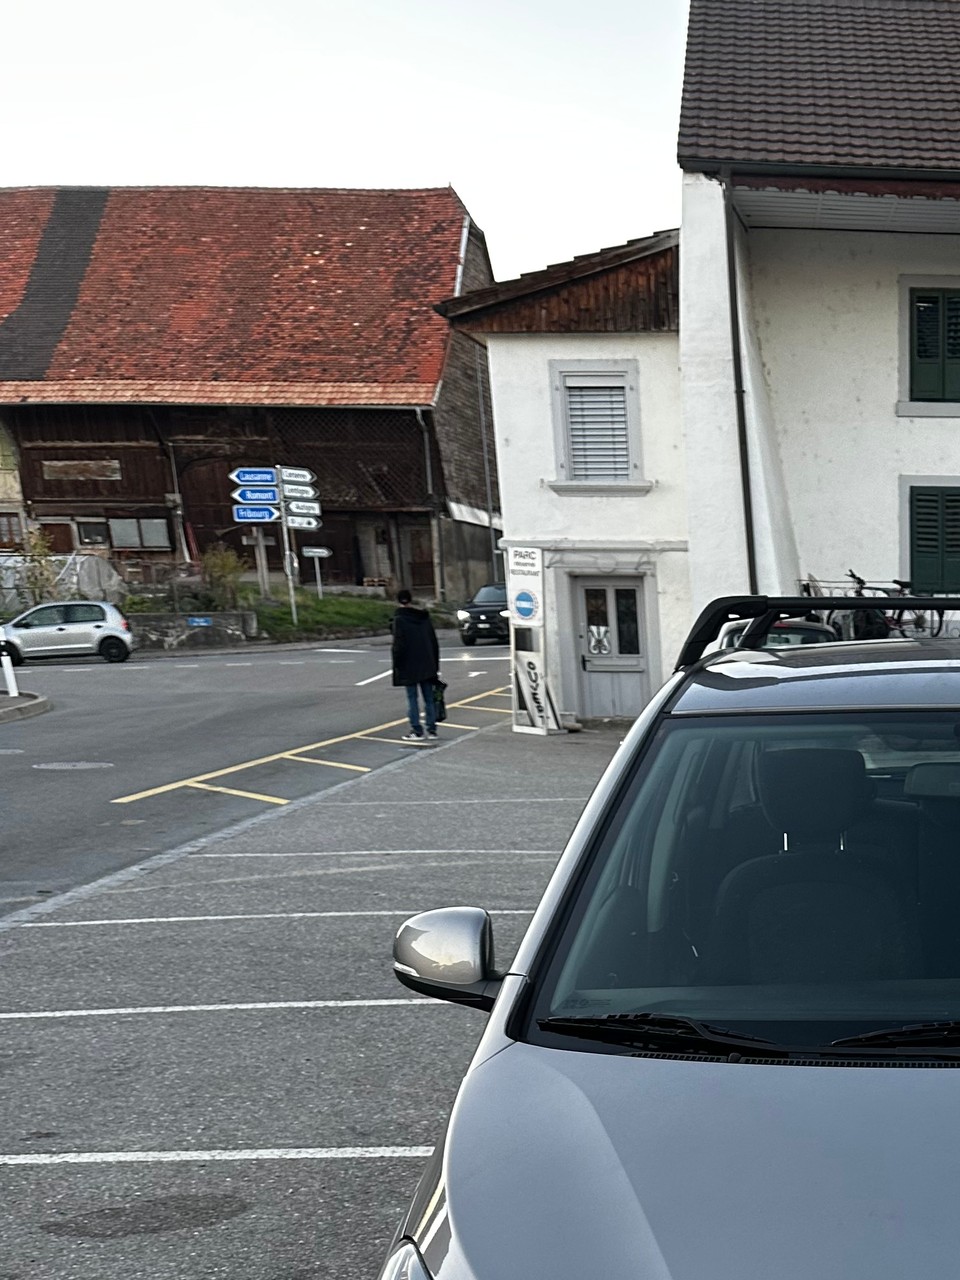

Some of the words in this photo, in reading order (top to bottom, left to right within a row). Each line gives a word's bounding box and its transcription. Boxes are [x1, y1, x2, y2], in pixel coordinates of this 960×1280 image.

[240, 472, 272, 481] Lausanne
[246, 490, 273, 499] Romont
[239, 508, 269, 520] Fribourg
[513, 550, 537, 560] PARC
